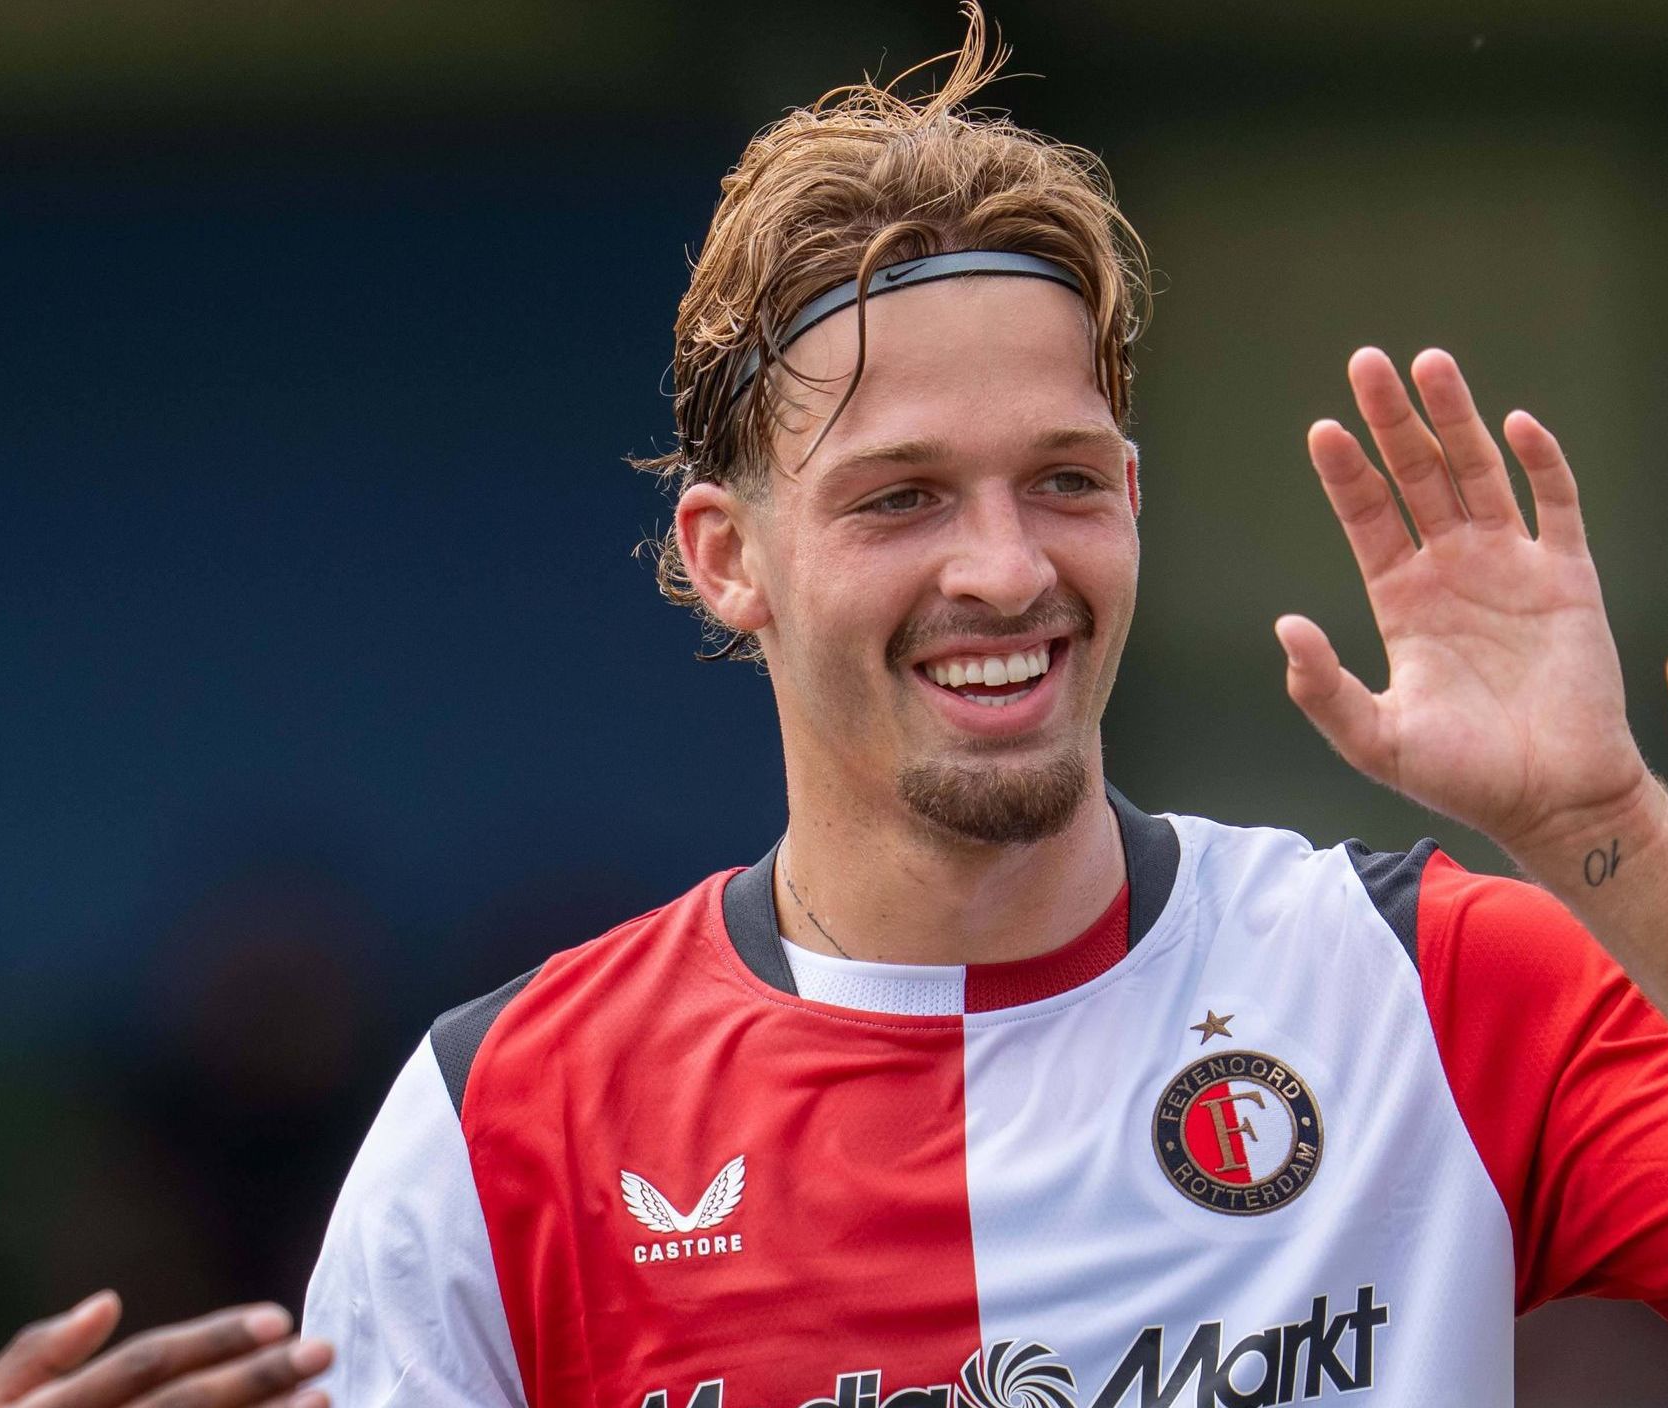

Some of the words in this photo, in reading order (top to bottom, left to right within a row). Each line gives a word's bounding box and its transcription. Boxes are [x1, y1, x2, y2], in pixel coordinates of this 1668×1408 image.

[1160, 1057, 1301, 1122] FEYENOORD
[1198, 1090, 1266, 1173] F
[1173, 1141, 1317, 1208] ROTTERDAM
[633, 1234, 744, 1264] CASTORE
